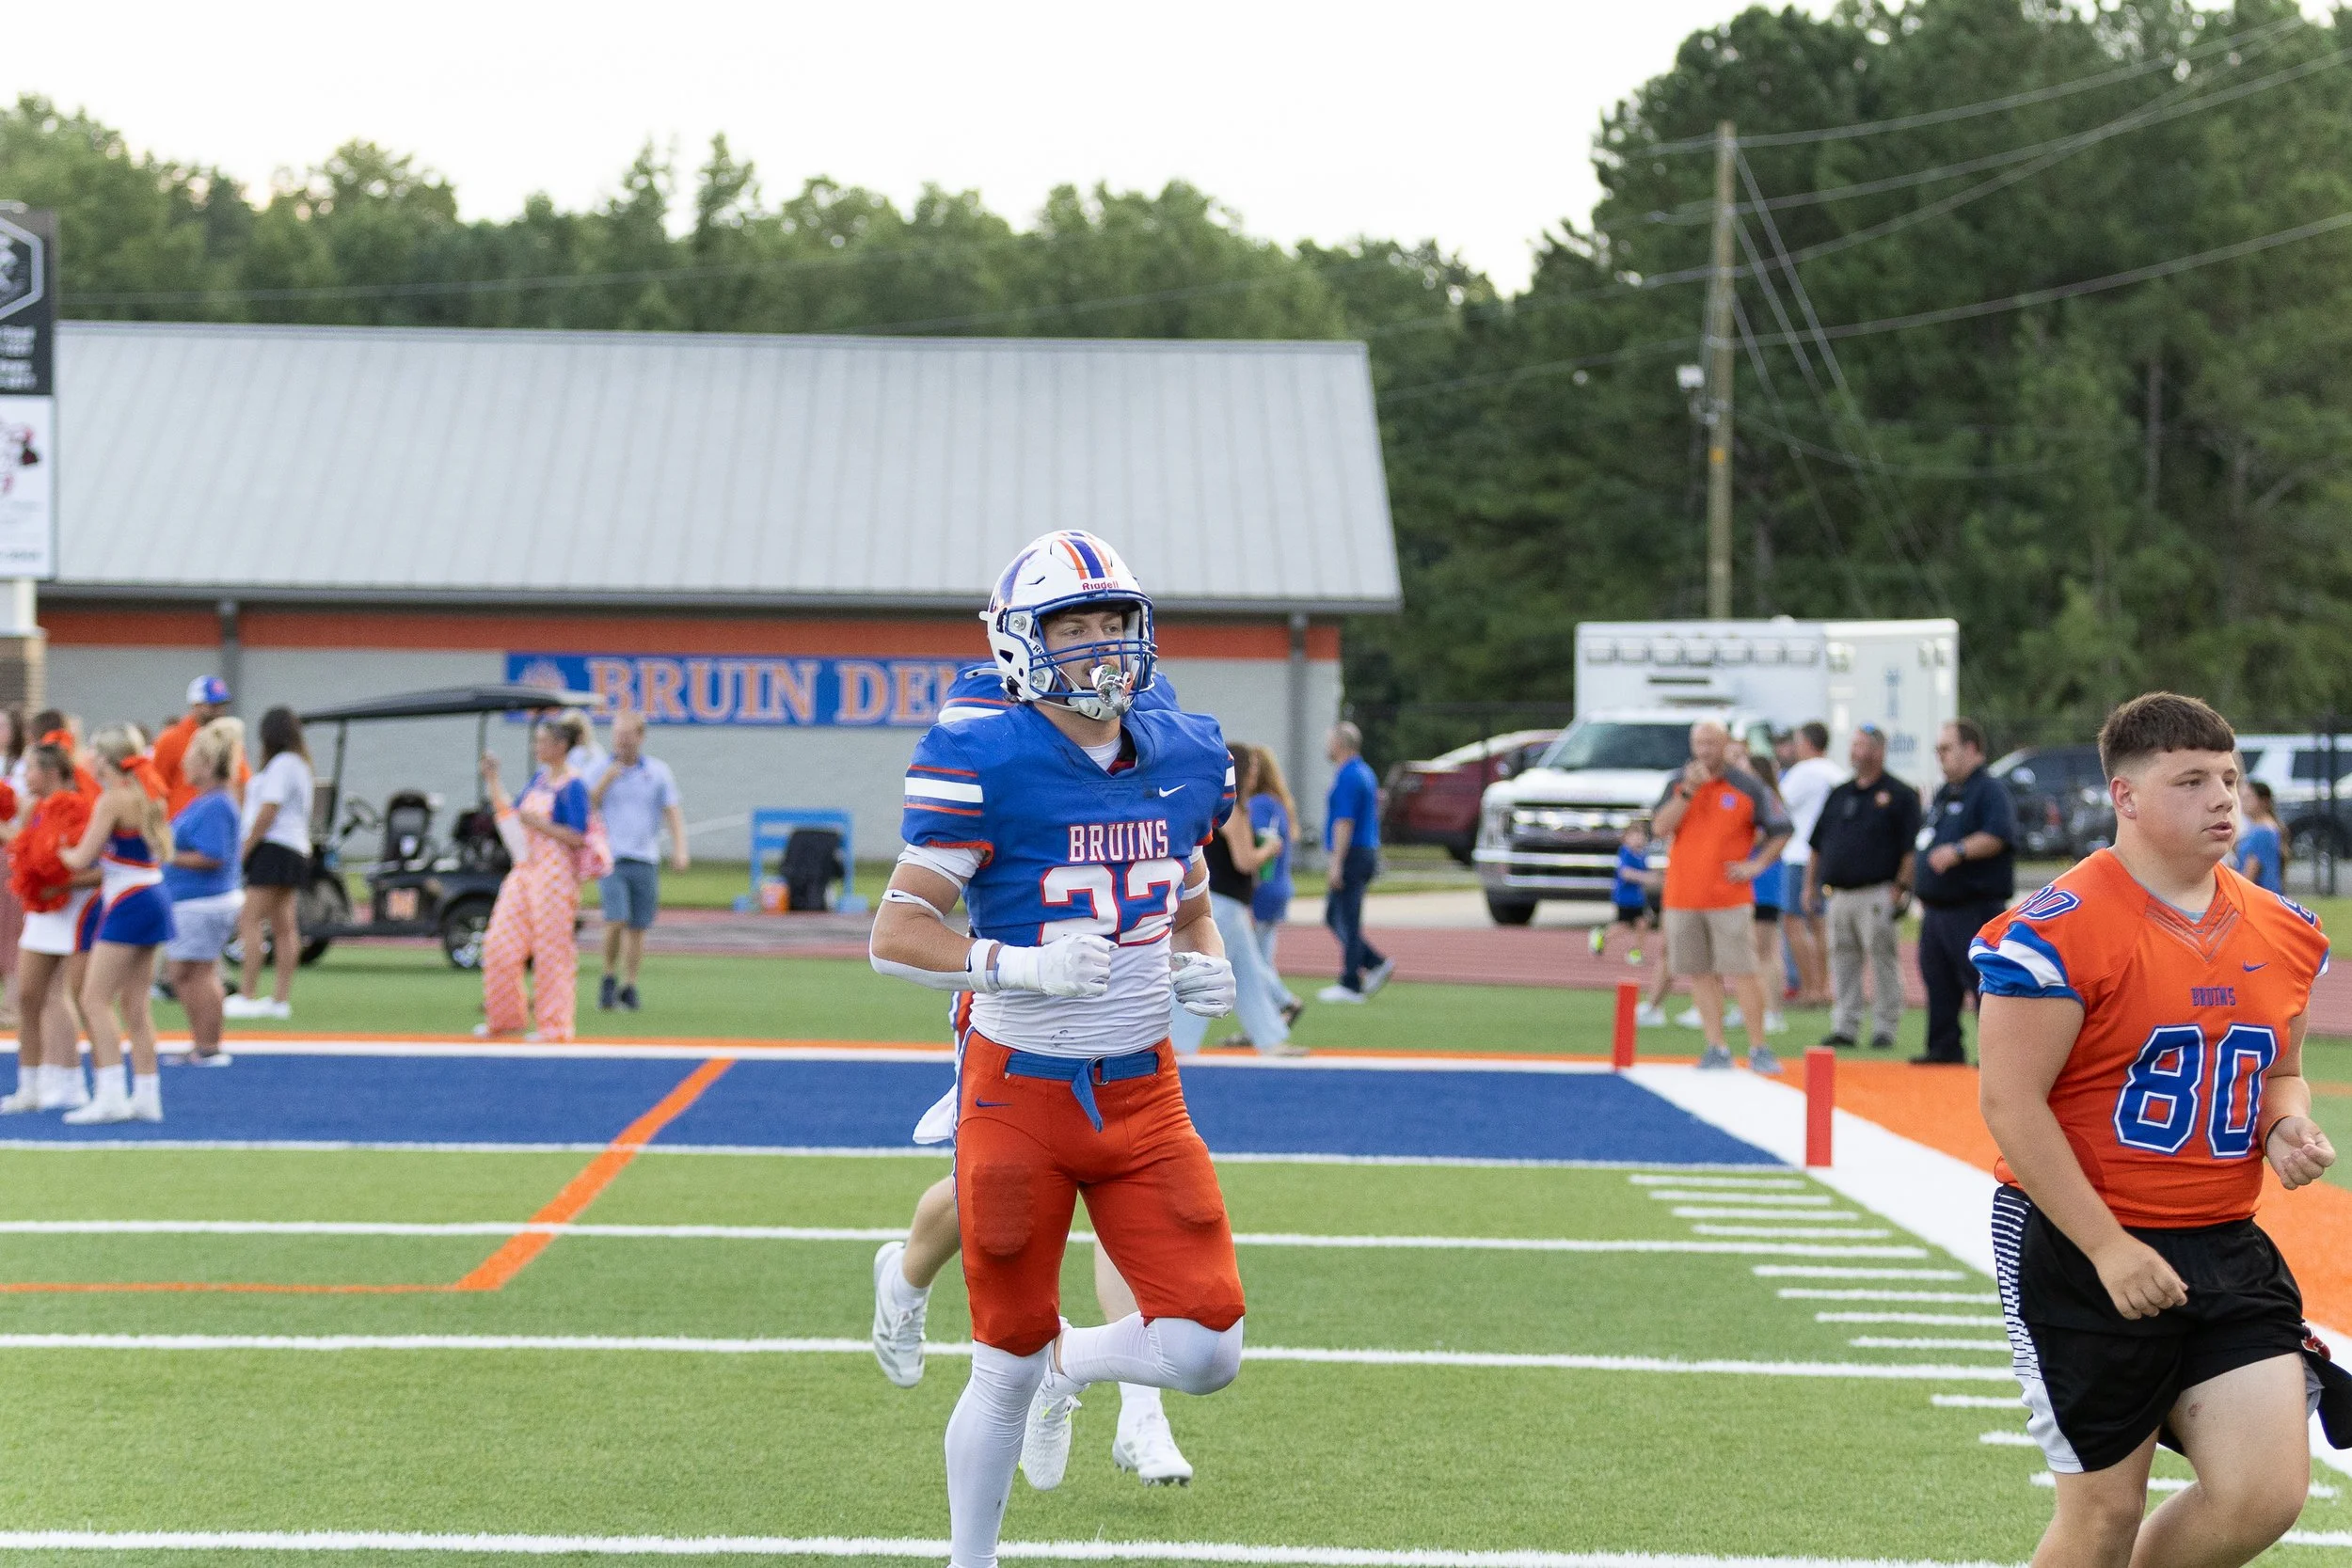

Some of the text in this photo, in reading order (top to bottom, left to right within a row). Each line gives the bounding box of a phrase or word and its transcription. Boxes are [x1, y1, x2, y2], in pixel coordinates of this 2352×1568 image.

[586, 658, 820, 722] BRUIN
[1068, 819, 1169, 863] BRUINS
[1039, 857, 1185, 946] 22
[2190, 986, 2236, 1006] BRUINS
[2111, 1022, 2280, 1159] 80
